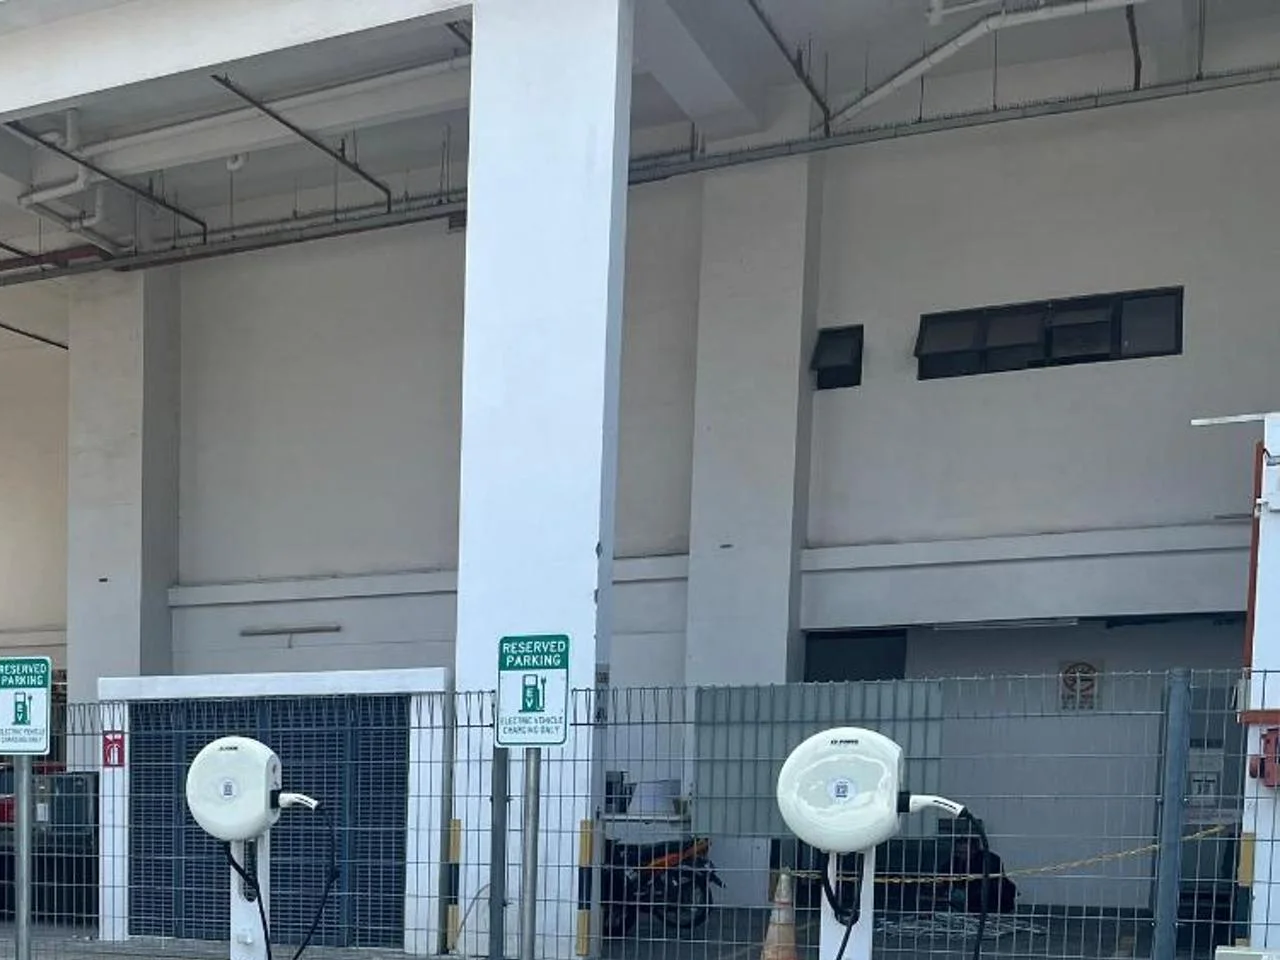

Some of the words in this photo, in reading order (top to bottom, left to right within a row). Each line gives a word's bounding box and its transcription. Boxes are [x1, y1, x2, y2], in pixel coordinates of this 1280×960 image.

[502, 640, 566, 654] RESERVED
[506, 655, 561, 667] PARKING
[1, 675, 43, 685] PARKING
